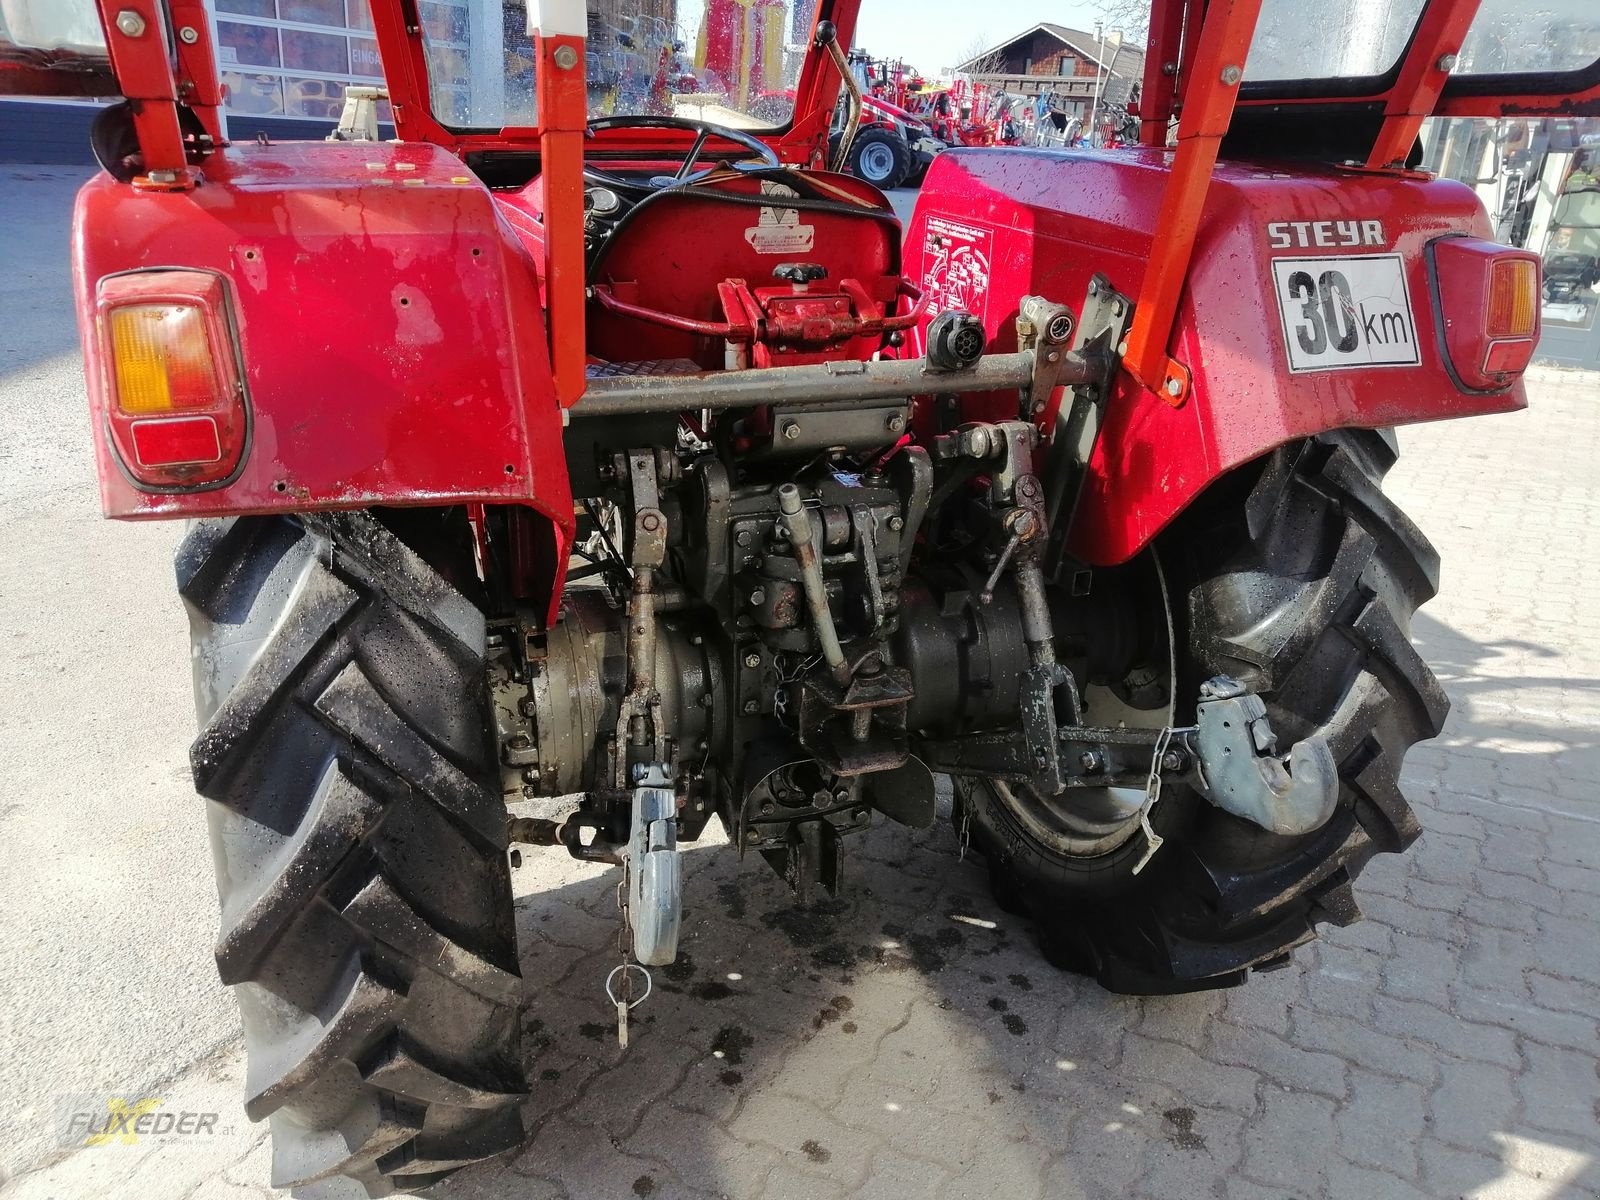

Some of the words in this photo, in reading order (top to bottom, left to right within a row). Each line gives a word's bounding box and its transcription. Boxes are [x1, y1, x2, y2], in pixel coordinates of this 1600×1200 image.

[1268, 220, 1385, 248] STEYR
[1288, 270, 1359, 355] 30
[1360, 303, 1408, 344] km
